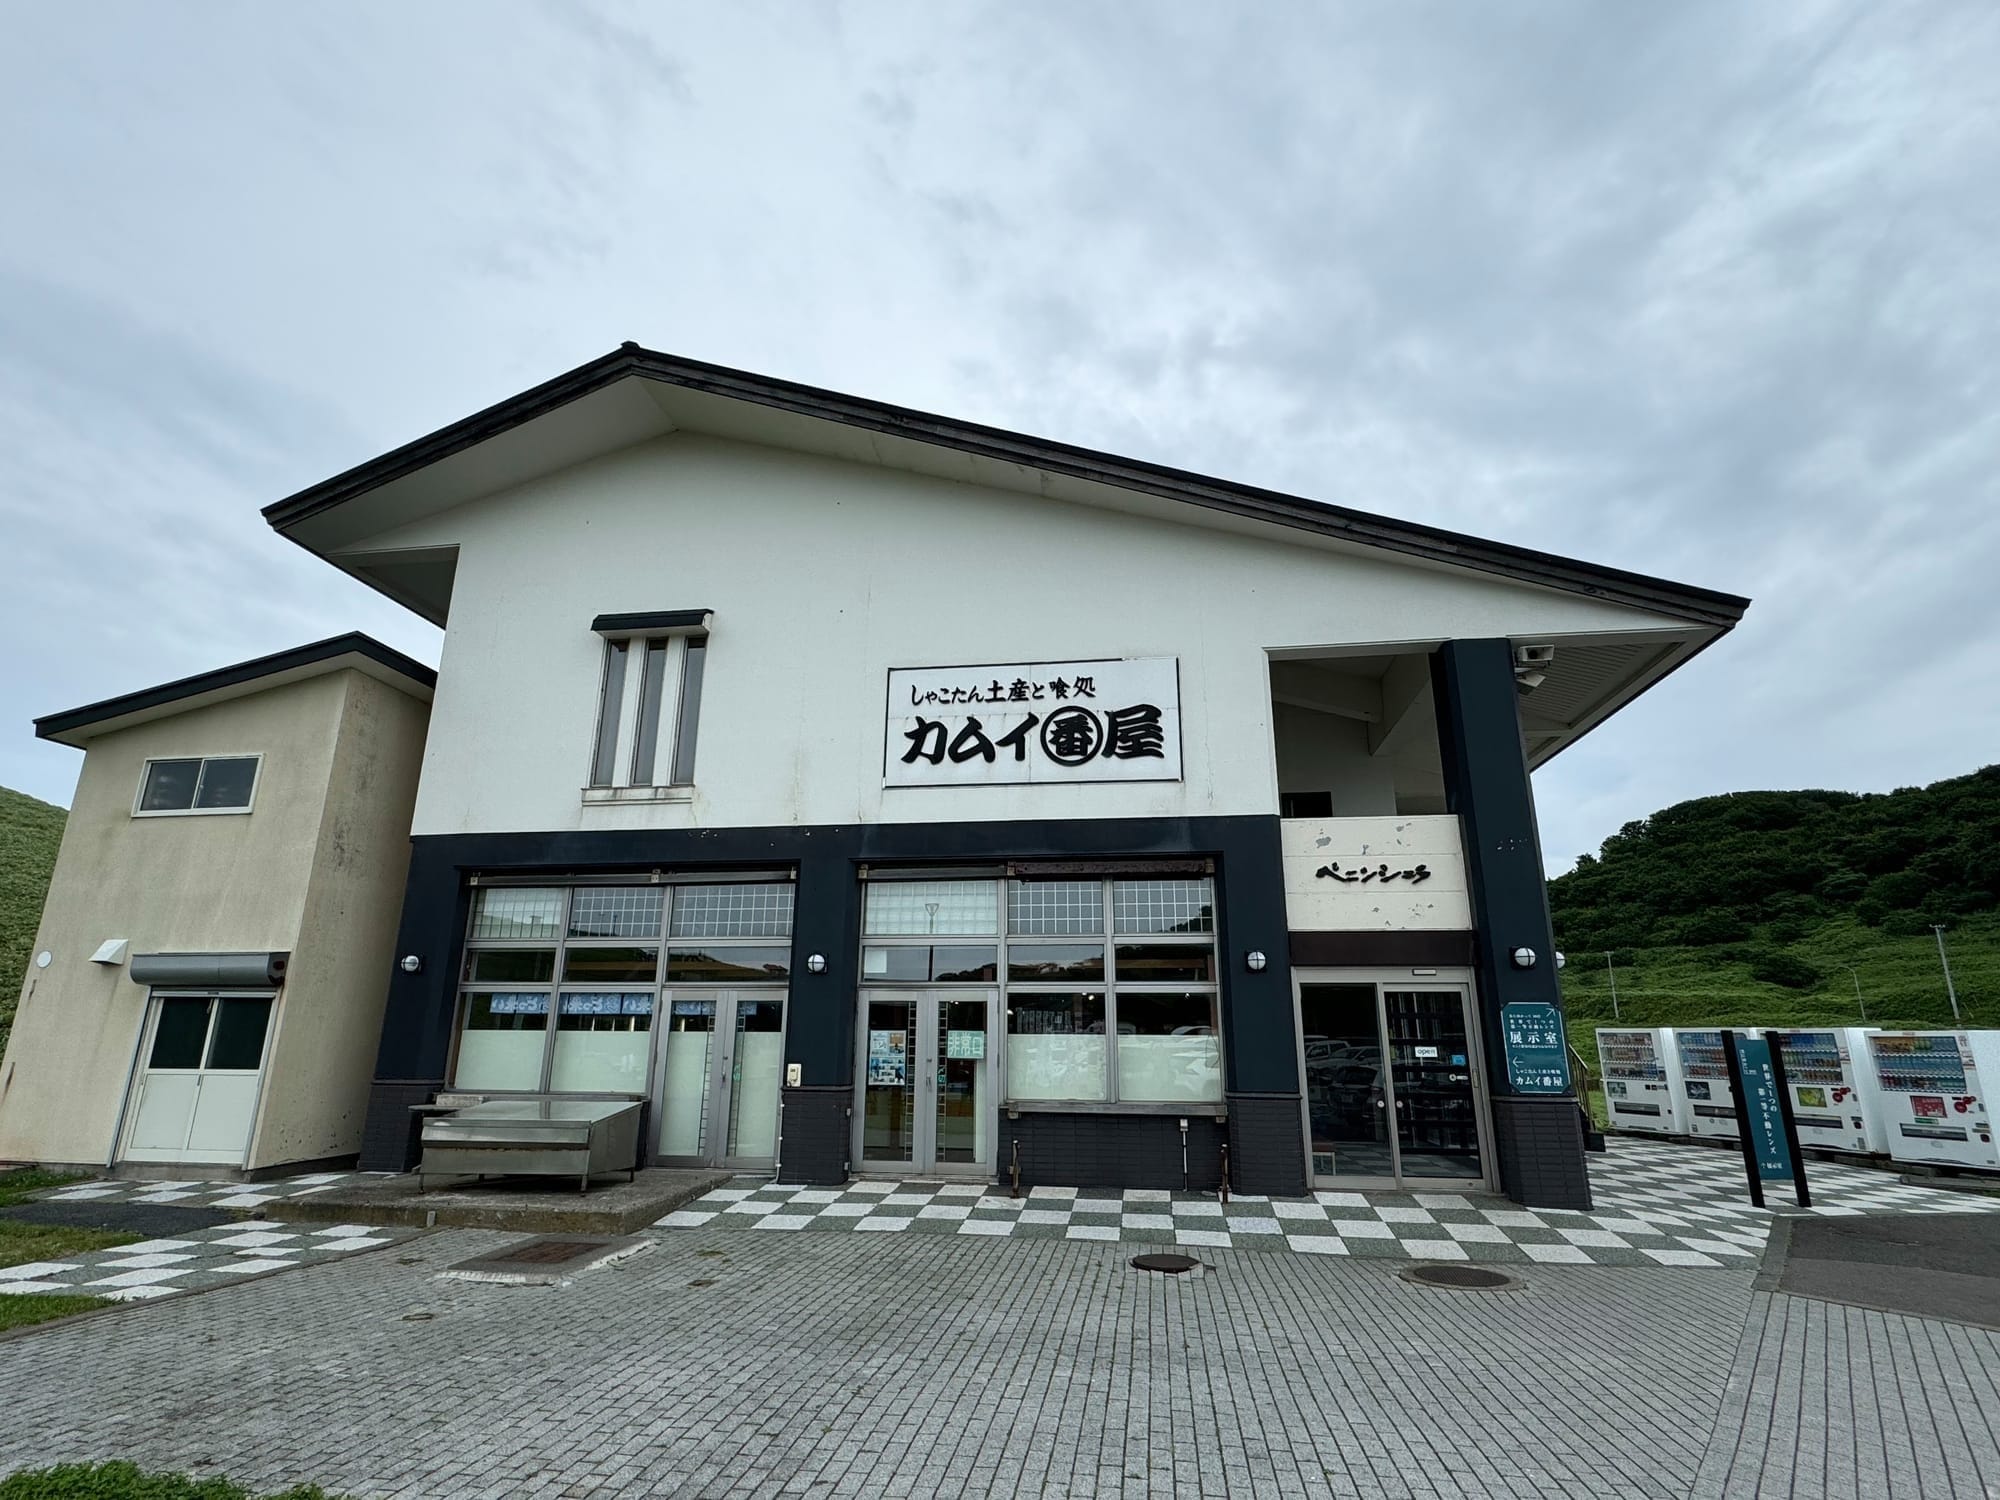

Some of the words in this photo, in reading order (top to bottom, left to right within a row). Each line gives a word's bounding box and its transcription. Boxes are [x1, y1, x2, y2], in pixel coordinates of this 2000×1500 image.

[911, 675, 1096, 705] しゃこたん土産と喰処
[900, 703, 1165, 767] カムイ番屋
[1510, 1031, 1558, 1044] 展示室
[1516, 1076, 1563, 1087] カムイ番屋
